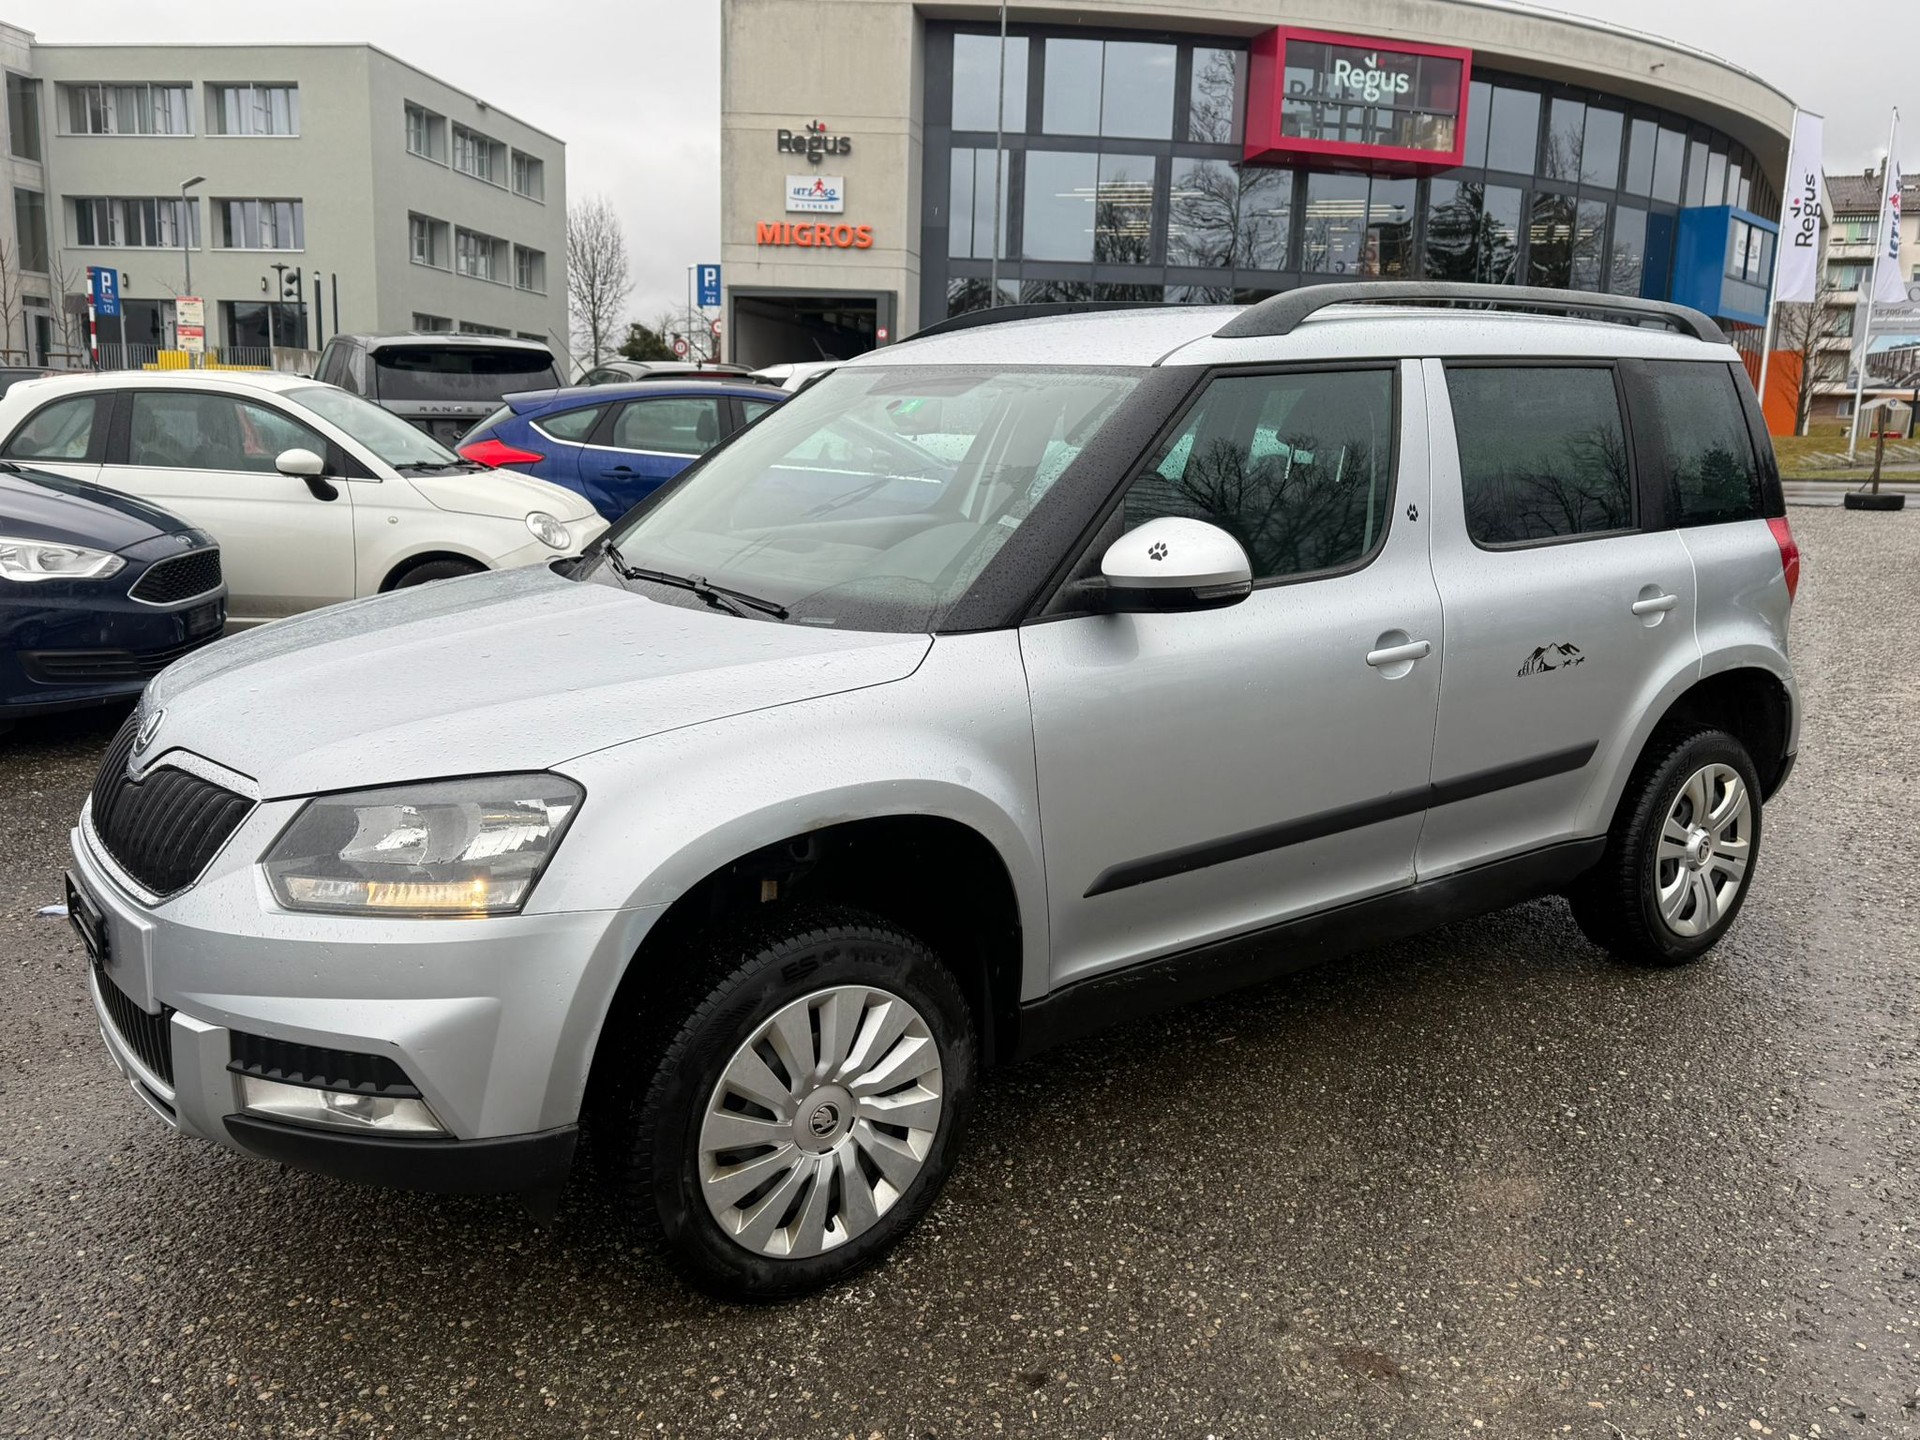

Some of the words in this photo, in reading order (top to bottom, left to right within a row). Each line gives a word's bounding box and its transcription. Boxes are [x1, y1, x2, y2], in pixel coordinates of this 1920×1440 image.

[1334, 58, 1410, 103] Regus
[777, 128, 852, 165] Regus
[1795, 173, 1821, 247] Regus
[756, 221, 874, 249] MIGROS
[101, 271, 112, 294] P
[704, 267, 717, 287] P
[103, 304, 114, 314] 121
